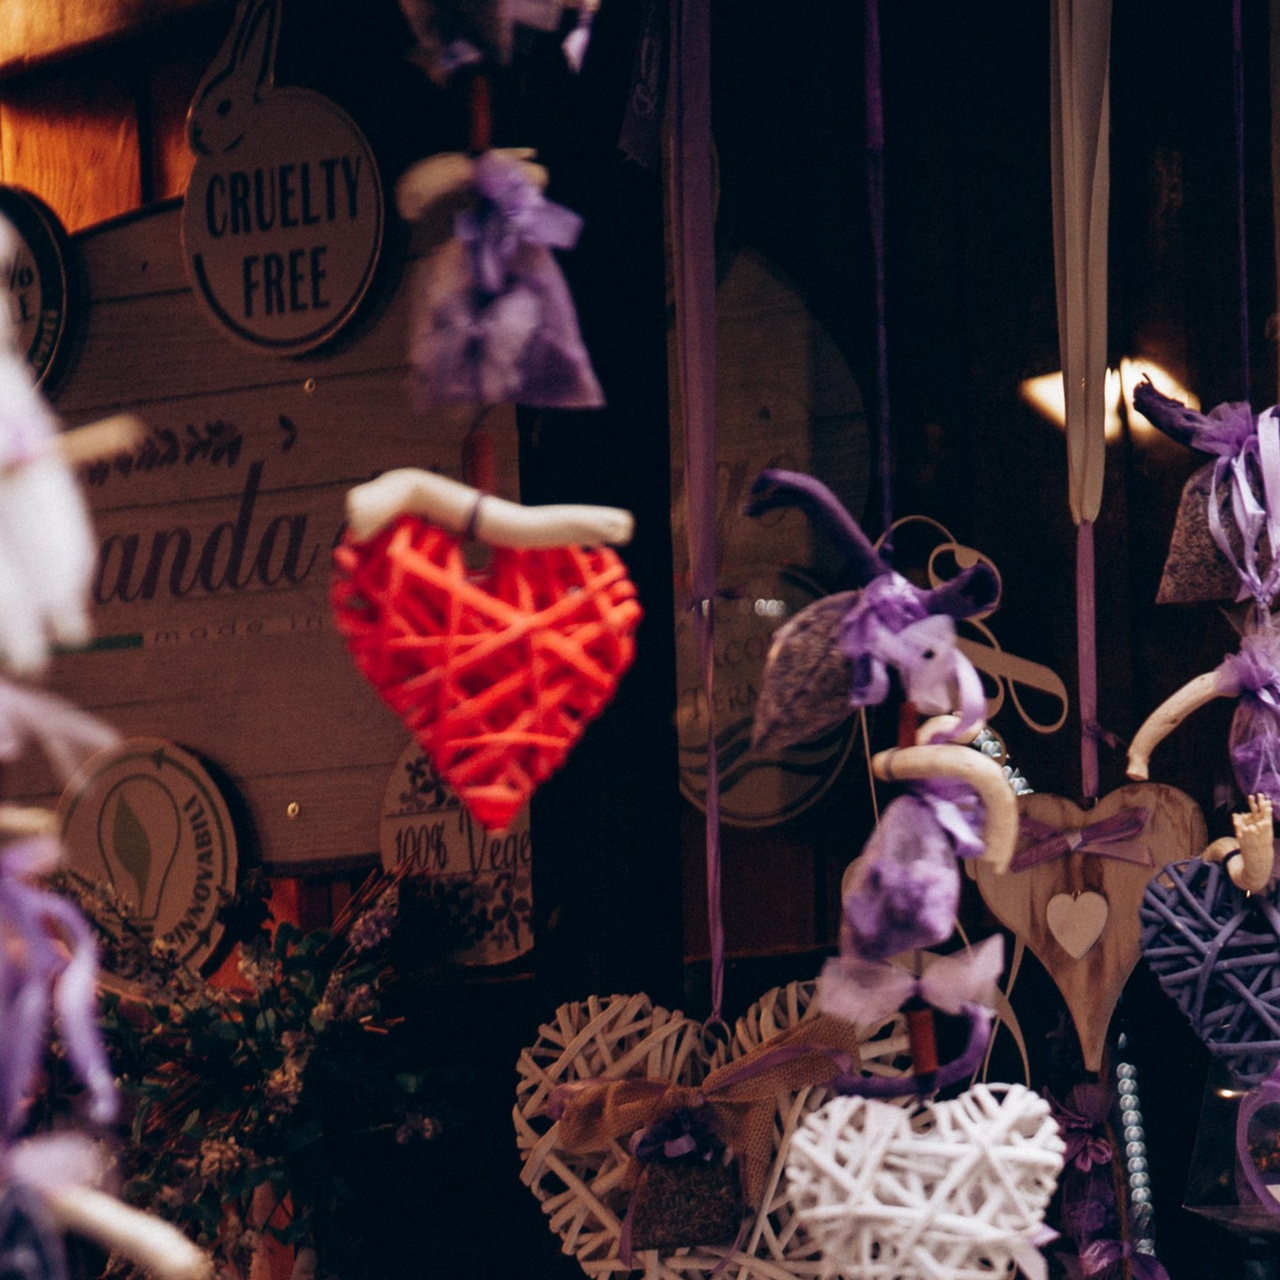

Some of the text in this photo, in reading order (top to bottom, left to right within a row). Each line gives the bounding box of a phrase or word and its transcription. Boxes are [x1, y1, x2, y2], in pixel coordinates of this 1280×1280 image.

[206, 155, 361, 237] CRUELTY
[243, 245, 330, 317] FREE
[92, 459, 320, 604] anda
[395, 820, 447, 872] 100%
